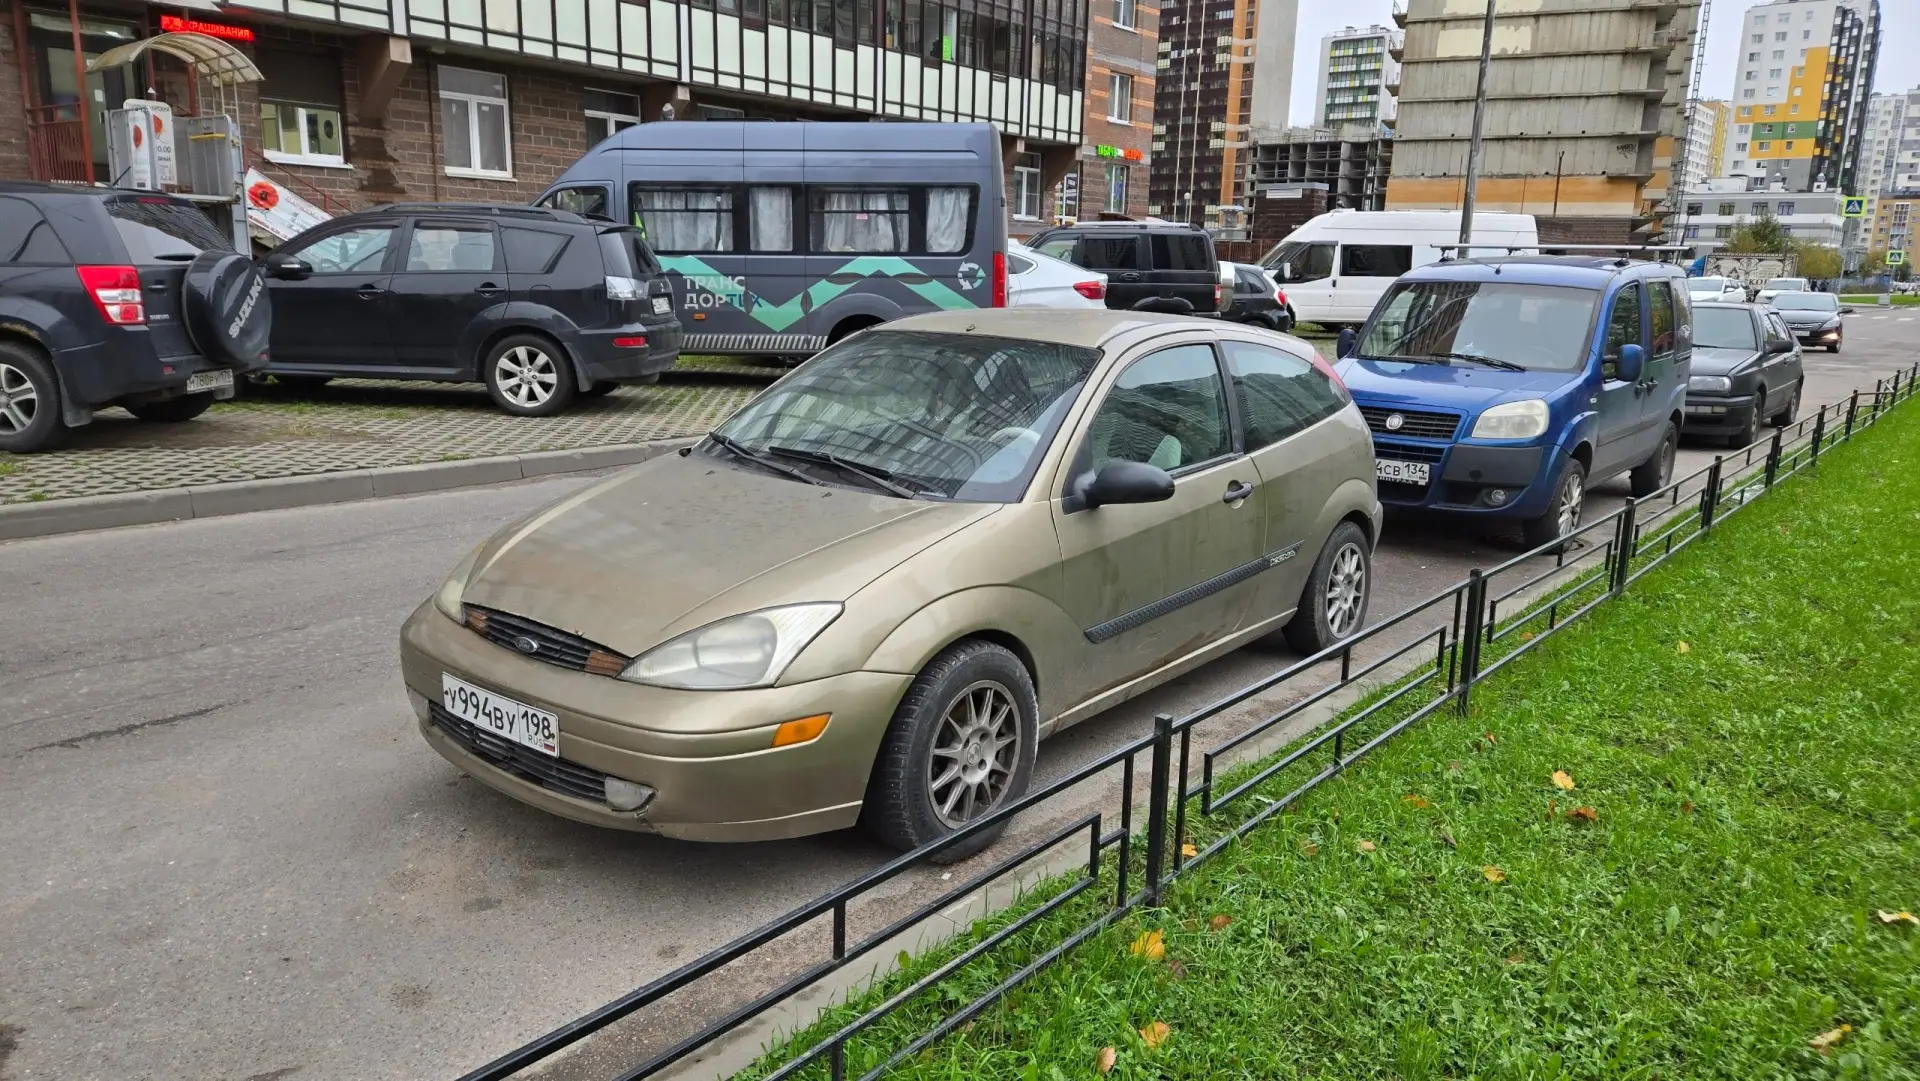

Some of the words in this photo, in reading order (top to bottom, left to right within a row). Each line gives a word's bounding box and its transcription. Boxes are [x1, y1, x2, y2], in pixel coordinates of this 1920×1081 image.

[682, 276, 746, 290] ТРАНС
[228, 274, 263, 338] SUZUKI
[1405, 463, 1425, 476] 134
[448, 686, 516, 735] У994ВУ
[521, 710, 551, 740] 198
[528, 734, 544, 748] RUS
